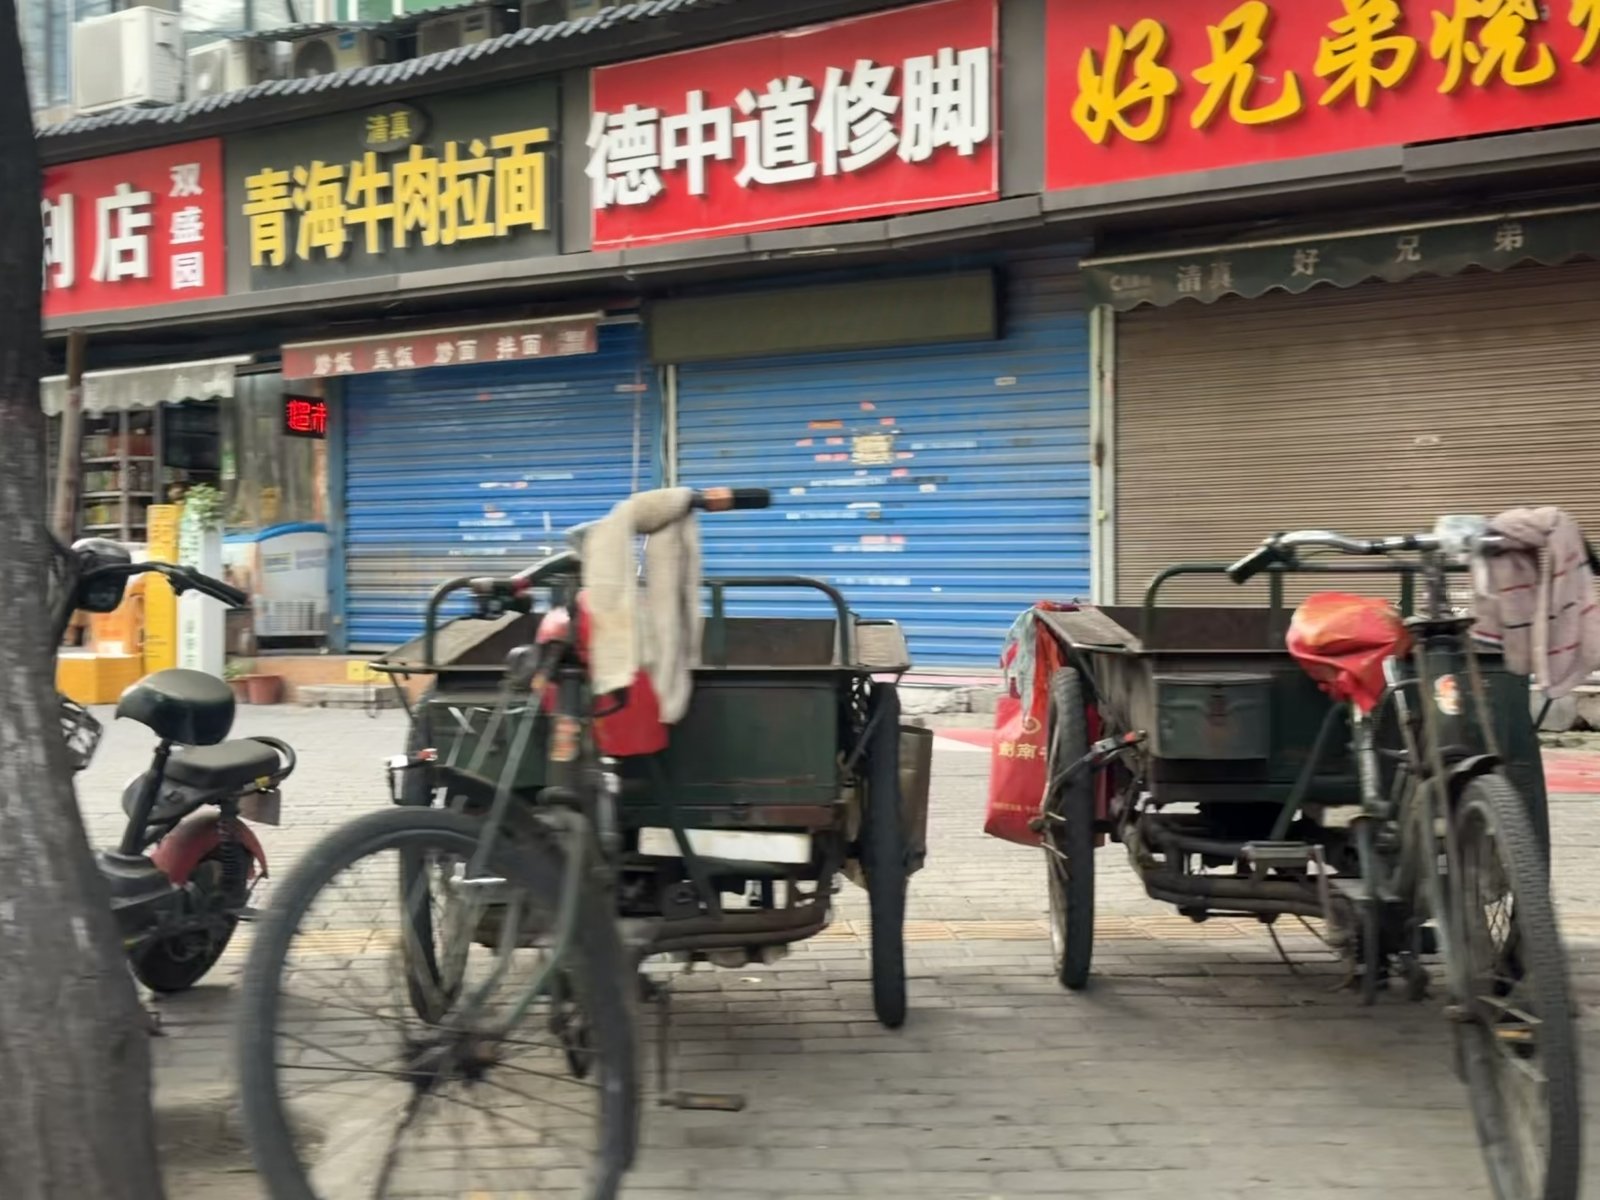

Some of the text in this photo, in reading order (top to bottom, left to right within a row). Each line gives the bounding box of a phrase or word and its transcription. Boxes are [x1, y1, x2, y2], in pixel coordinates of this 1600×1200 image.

[242, 127, 549, 268] 青海牛肉拉面
[365, 110, 412, 144] 清真
[584, 46, 989, 209] 德中道修脚
